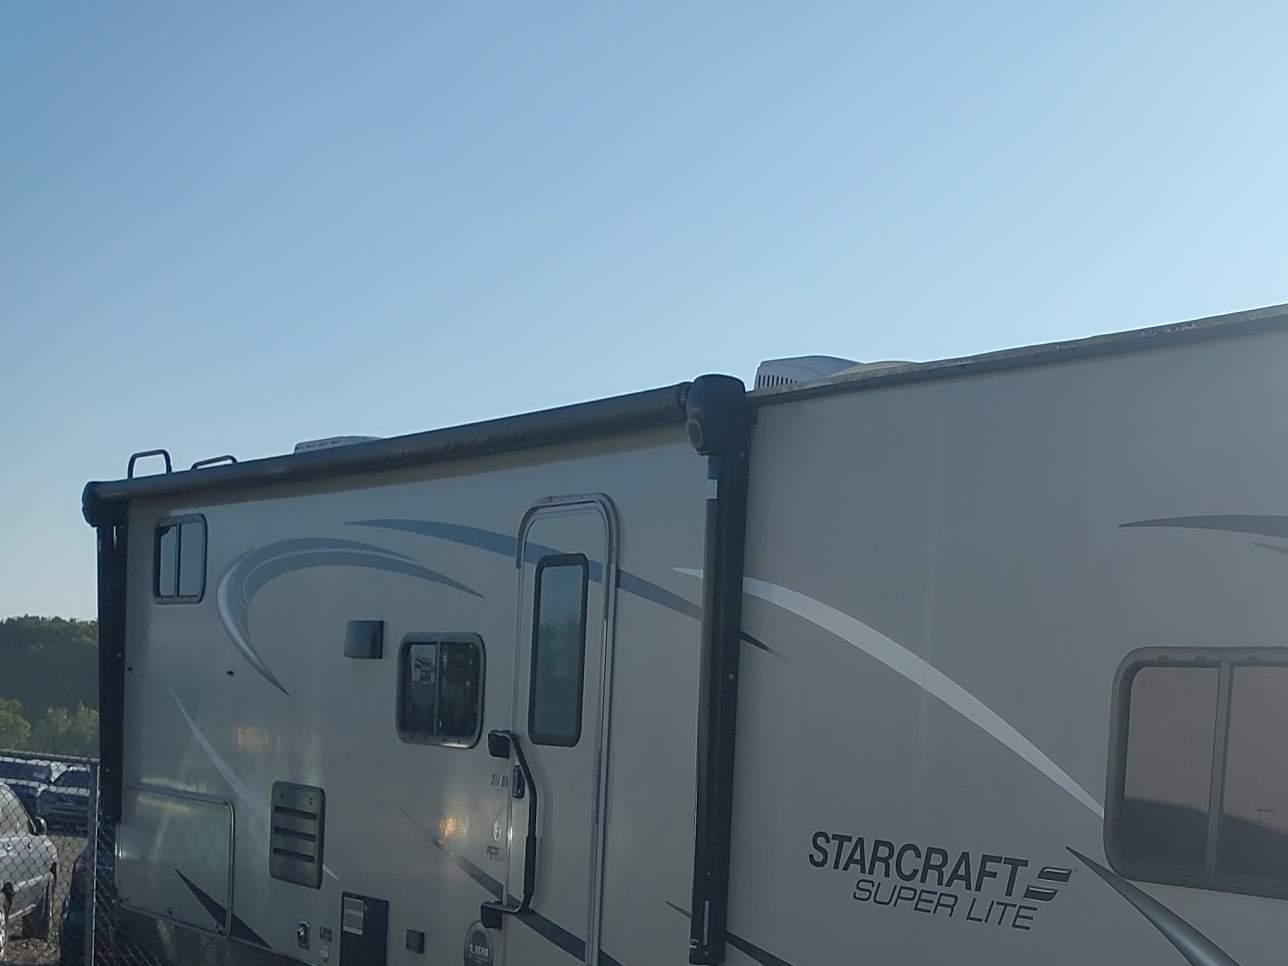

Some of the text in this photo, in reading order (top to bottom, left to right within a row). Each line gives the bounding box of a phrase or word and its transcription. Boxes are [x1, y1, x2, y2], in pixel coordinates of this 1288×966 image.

[808, 831, 1029, 897] STARCRAFT
[853, 879, 1038, 930] SUPER LITE
